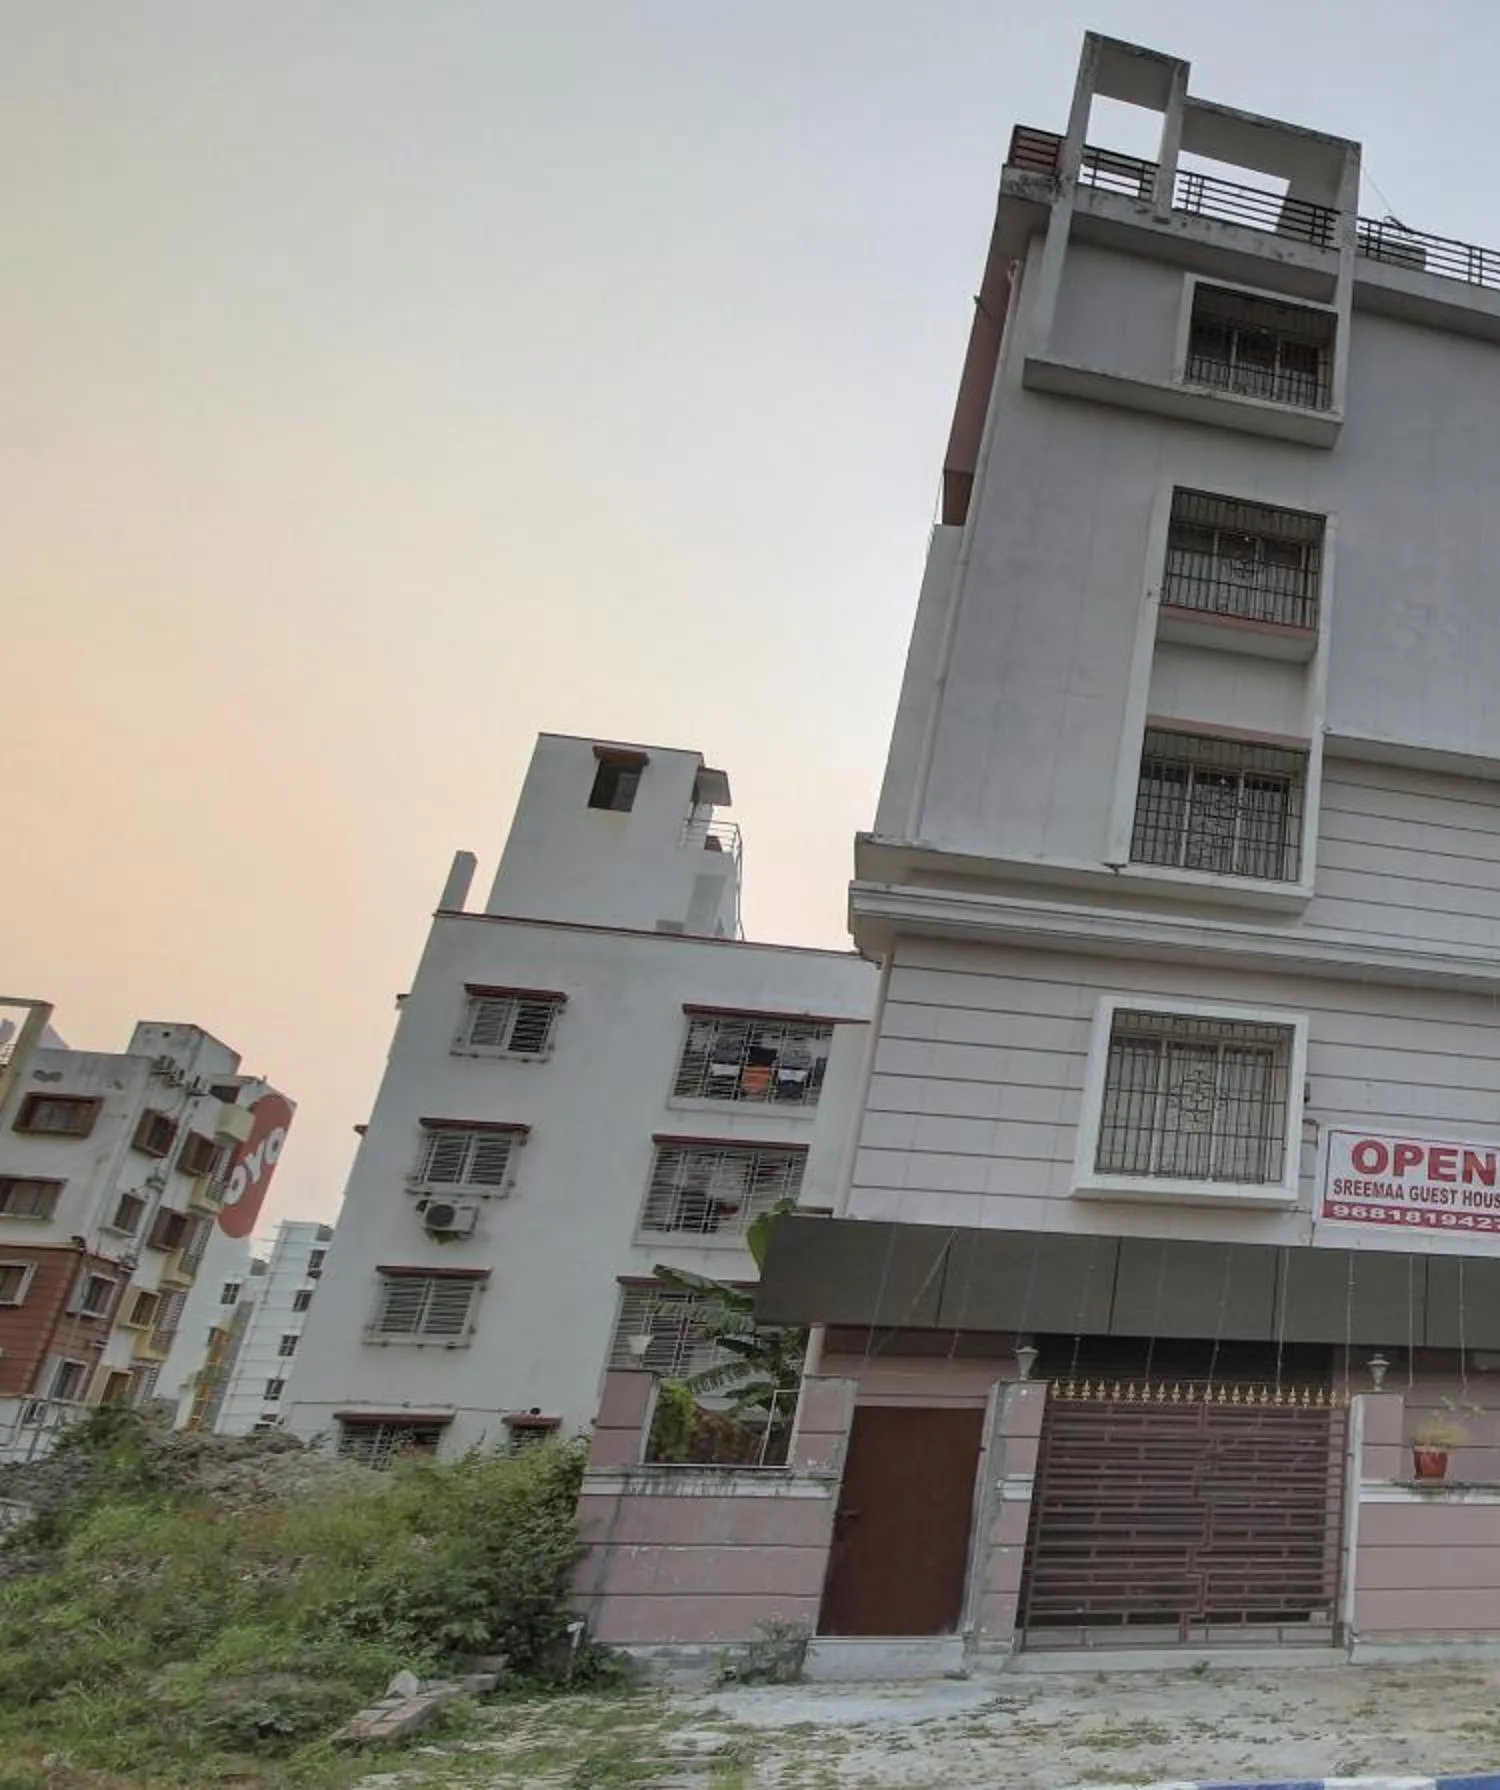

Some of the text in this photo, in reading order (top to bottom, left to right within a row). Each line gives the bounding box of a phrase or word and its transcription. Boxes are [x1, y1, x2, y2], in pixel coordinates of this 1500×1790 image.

[1351, 1139, 1497, 1187] OPEN
[1333, 1178, 1405, 1200] SREEMAA
[1409, 1185, 1458, 1205] GUEST
